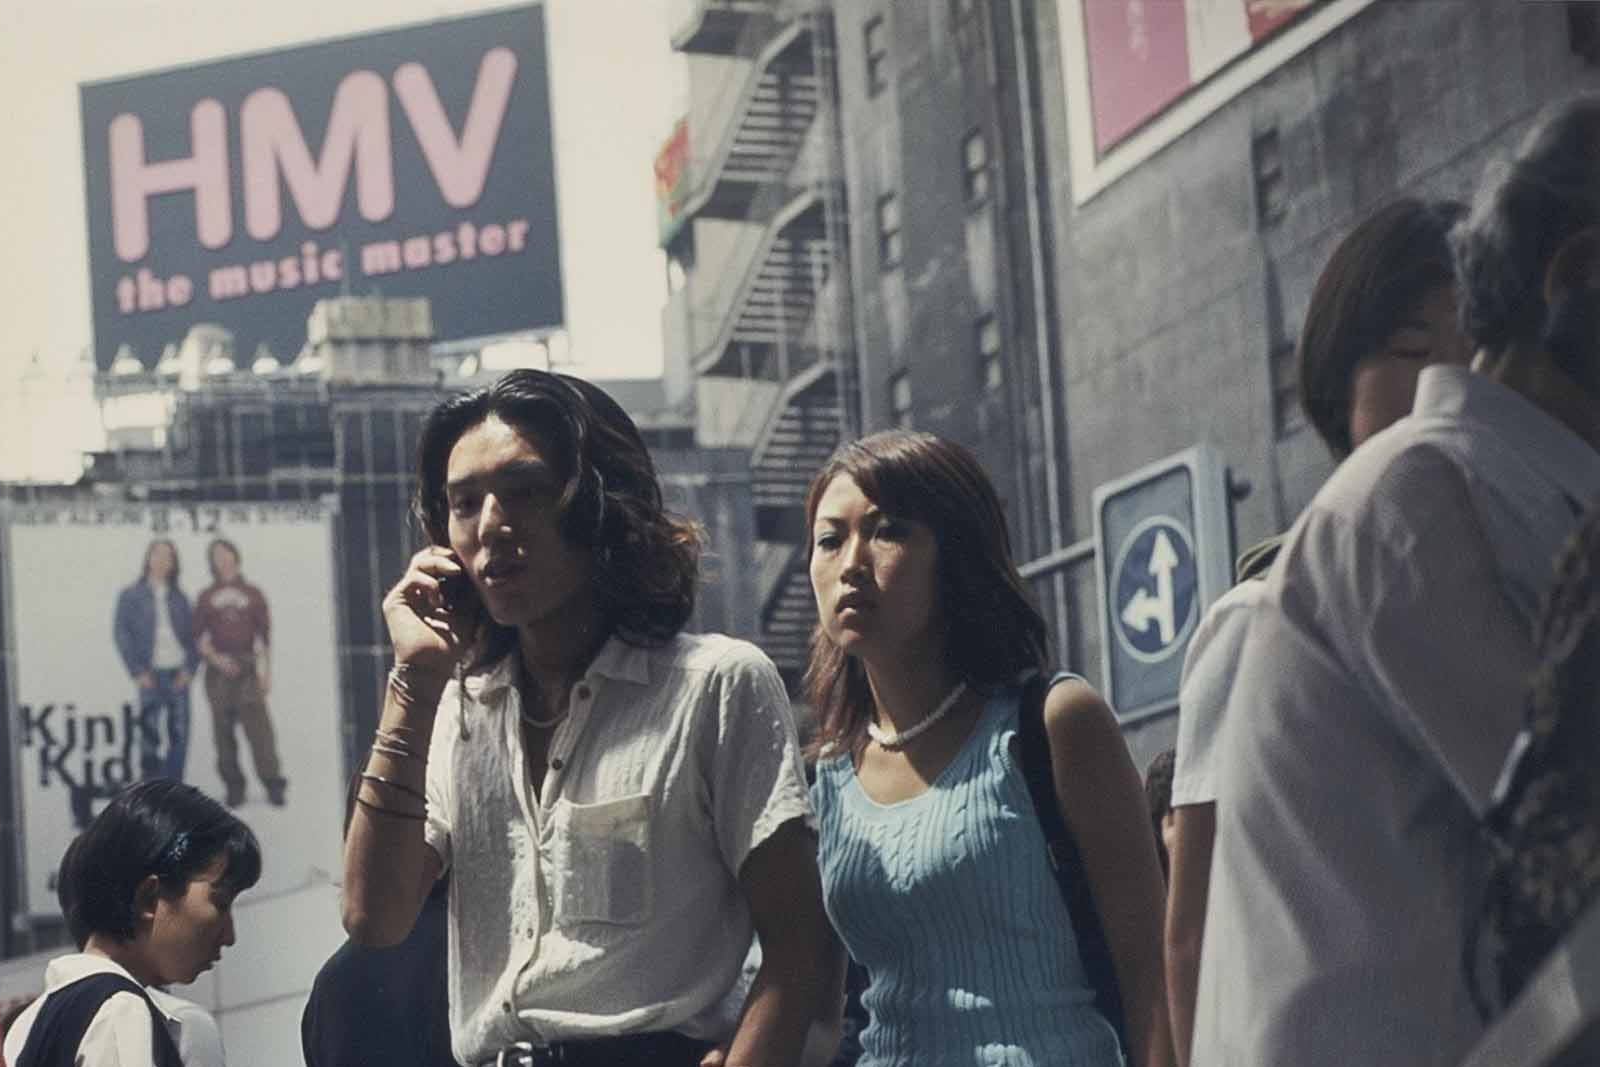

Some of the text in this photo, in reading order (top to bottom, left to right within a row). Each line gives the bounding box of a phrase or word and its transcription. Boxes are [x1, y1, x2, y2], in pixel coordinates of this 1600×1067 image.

[109, 48, 517, 262] HMV
[117, 219, 528, 313] the music master
